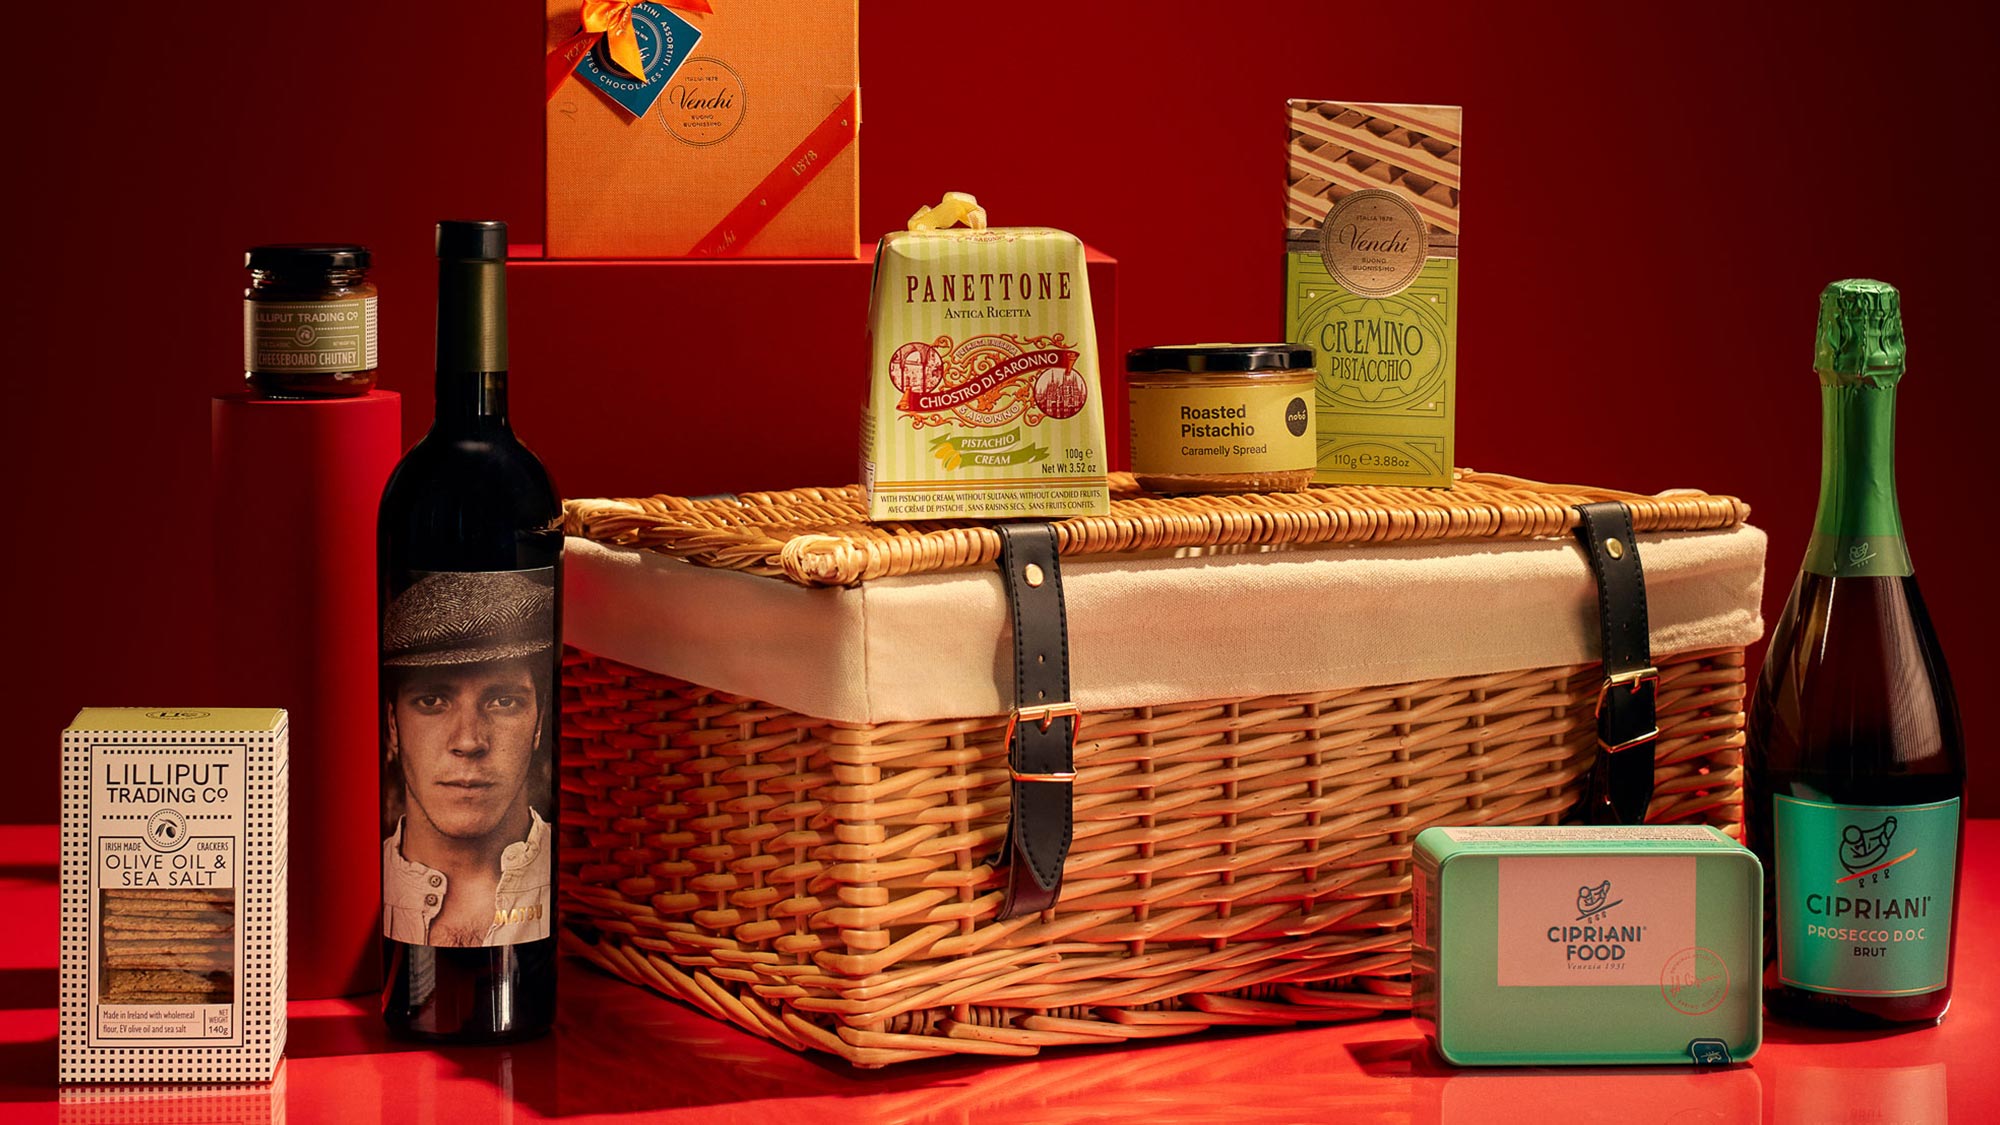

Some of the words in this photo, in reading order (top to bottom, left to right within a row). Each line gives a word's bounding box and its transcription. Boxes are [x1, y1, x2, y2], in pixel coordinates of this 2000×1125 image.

[660, 20, 674, 67] ASSORTITI
[599, 71, 662, 92] CHOCOLATES
[669, 84, 734, 110] Venchi
[791, 150, 818, 176] 1878
[1339, 223, 1410, 253] Venchi
[906, 271, 1071, 303] PANETTONE
[297, 312, 345, 322] TRADING
[944, 307, 984, 319] ANTICA
[986, 306, 1032, 318] RICETTA
[1320, 317, 1424, 356] CREMINO
[258, 352, 317, 366] CHEESEBOARD
[319, 350, 357, 366] CHUTNEY
[1331, 356, 1412, 382] PISTACCHIO
[919, 382, 982, 409] CHIOSTRO
[983, 374, 997, 389] DI
[995, 352, 1059, 381] SARONNO
[958, 403, 1020, 424] SARONNO
[1180, 404, 1246, 420] Roasted
[1181, 422, 1255, 438] Pistachio
[961, 434, 1015, 448] PISTACHIO
[1065, 448, 1083, 461] 100g
[1181, 445, 1230, 457] Caramelly
[1233, 444, 1267, 456] Spread
[974, 454, 1011, 465] CREAM
[1334, 454, 1357, 469] 110g
[1374, 455, 1410, 467] 3.88oz
[1041, 463, 1055, 474] Net
[1056, 463, 1068, 473] Wt
[1069, 462, 1086, 473] 3.52
[1087, 464, 1097, 473] oz
[880, 495, 898, 503] WITH
[898, 495, 931, 503] PISTACHIO
[931, 494, 955, 502] CREAM,
[956, 493, 986, 501] WITHOUT
[1019, 491, 1049, 500] WITHOUT
[1050, 490, 1079, 499] CANDIED
[1080, 489, 1102, 498] FRUITS.
[904, 504, 925, 513] CRÈME
[926, 505, 935, 513] DE
[968, 504, 984, 512] SANS
[985, 503, 1009, 511] RAISINS
[1009, 502, 1026, 511] SECS,
[1028, 502, 1045, 510] SANS
[1046, 501, 1067, 509] FRUITS
[1067, 501, 1096, 509] CONFITS.
[106, 763, 229, 785] LILLIPUT
[106, 787, 195, 803] TRADING
[105, 842, 122, 851] IRISH
[123, 842, 142, 851] MADE
[197, 842, 229, 851] CRACKERS
[105, 854, 163, 870] OLIVE
[172, 854, 205, 870] OIL
[214, 854, 227, 870] &
[122, 871, 160, 886] SEA
[168, 871, 217, 886] SALT
[1808, 924, 1889, 942] PROSECCO
[1567, 944, 1626, 961] FOOD
[1853, 946, 1887, 957] BRUT
[1567, 962, 1601, 970] Venezia
[1605, 962, 1625, 970] 1931
[103, 1010, 119, 1019] Made
[120, 1010, 126, 1019] in
[127, 1010, 148, 1019] Ireland
[149, 1010, 163, 1019] with
[163, 1010, 195, 1019] wholemeal
[103, 1024, 118, 1034] flour,
[119, 1025, 127, 1033] EV
[128, 1024, 142, 1033] olive
[143, 1024, 151, 1033] oil
[151, 1024, 163, 1033] and
[175, 1024, 186, 1033] salt
[208, 1025, 229, 1035] 140g
